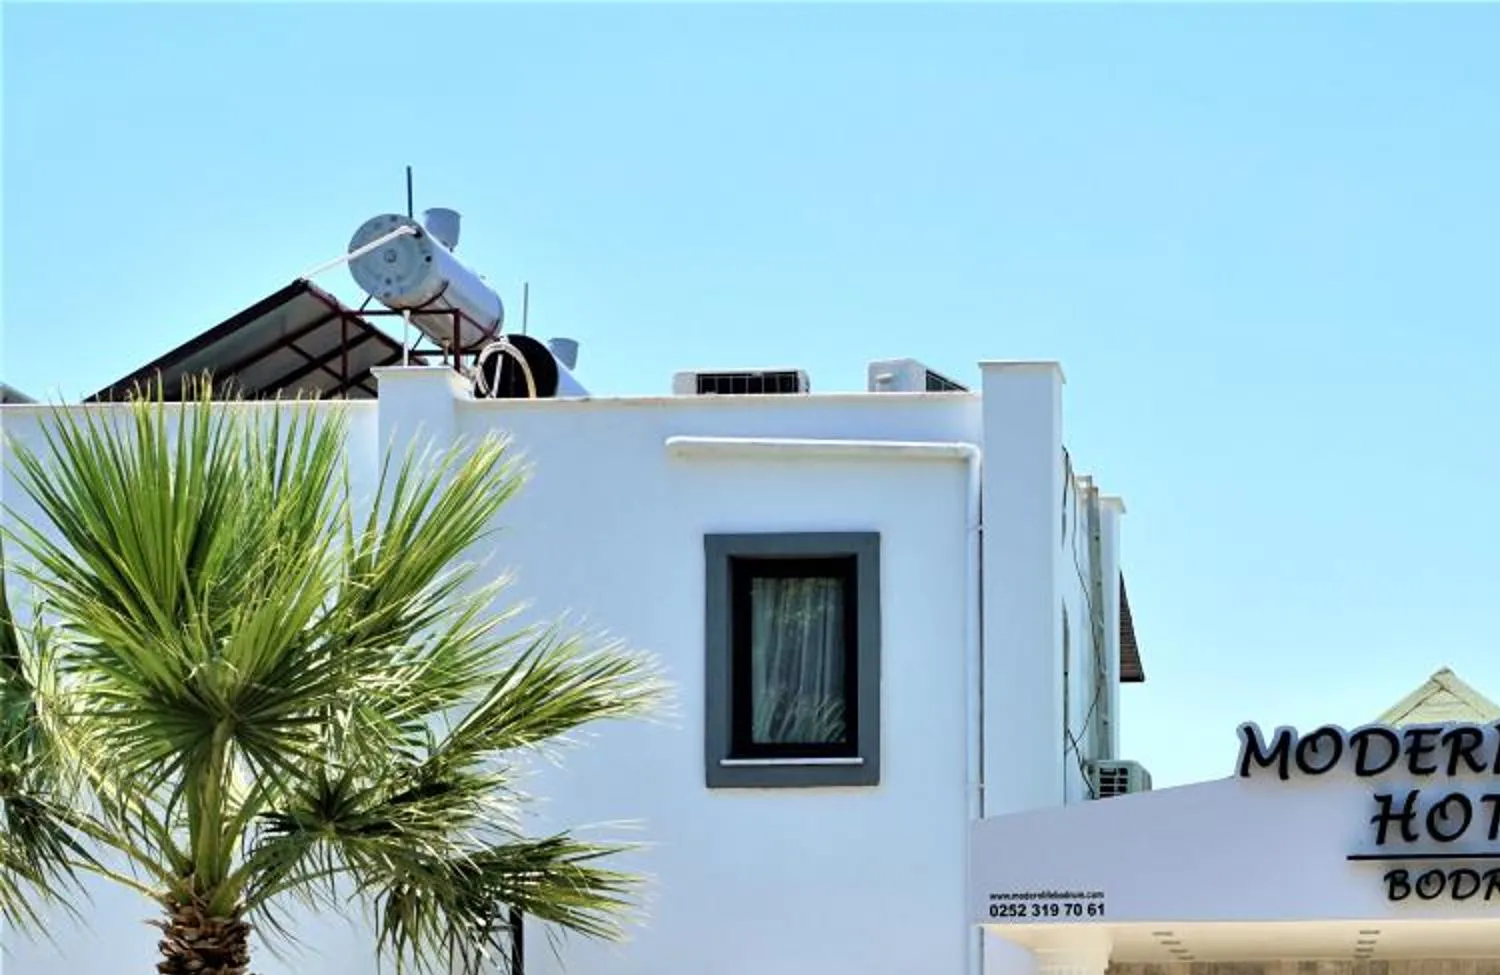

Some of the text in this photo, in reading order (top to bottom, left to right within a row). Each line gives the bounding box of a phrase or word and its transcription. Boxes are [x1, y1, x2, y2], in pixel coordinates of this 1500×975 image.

[989, 903, 1104, 916] 0252 319 70 61
